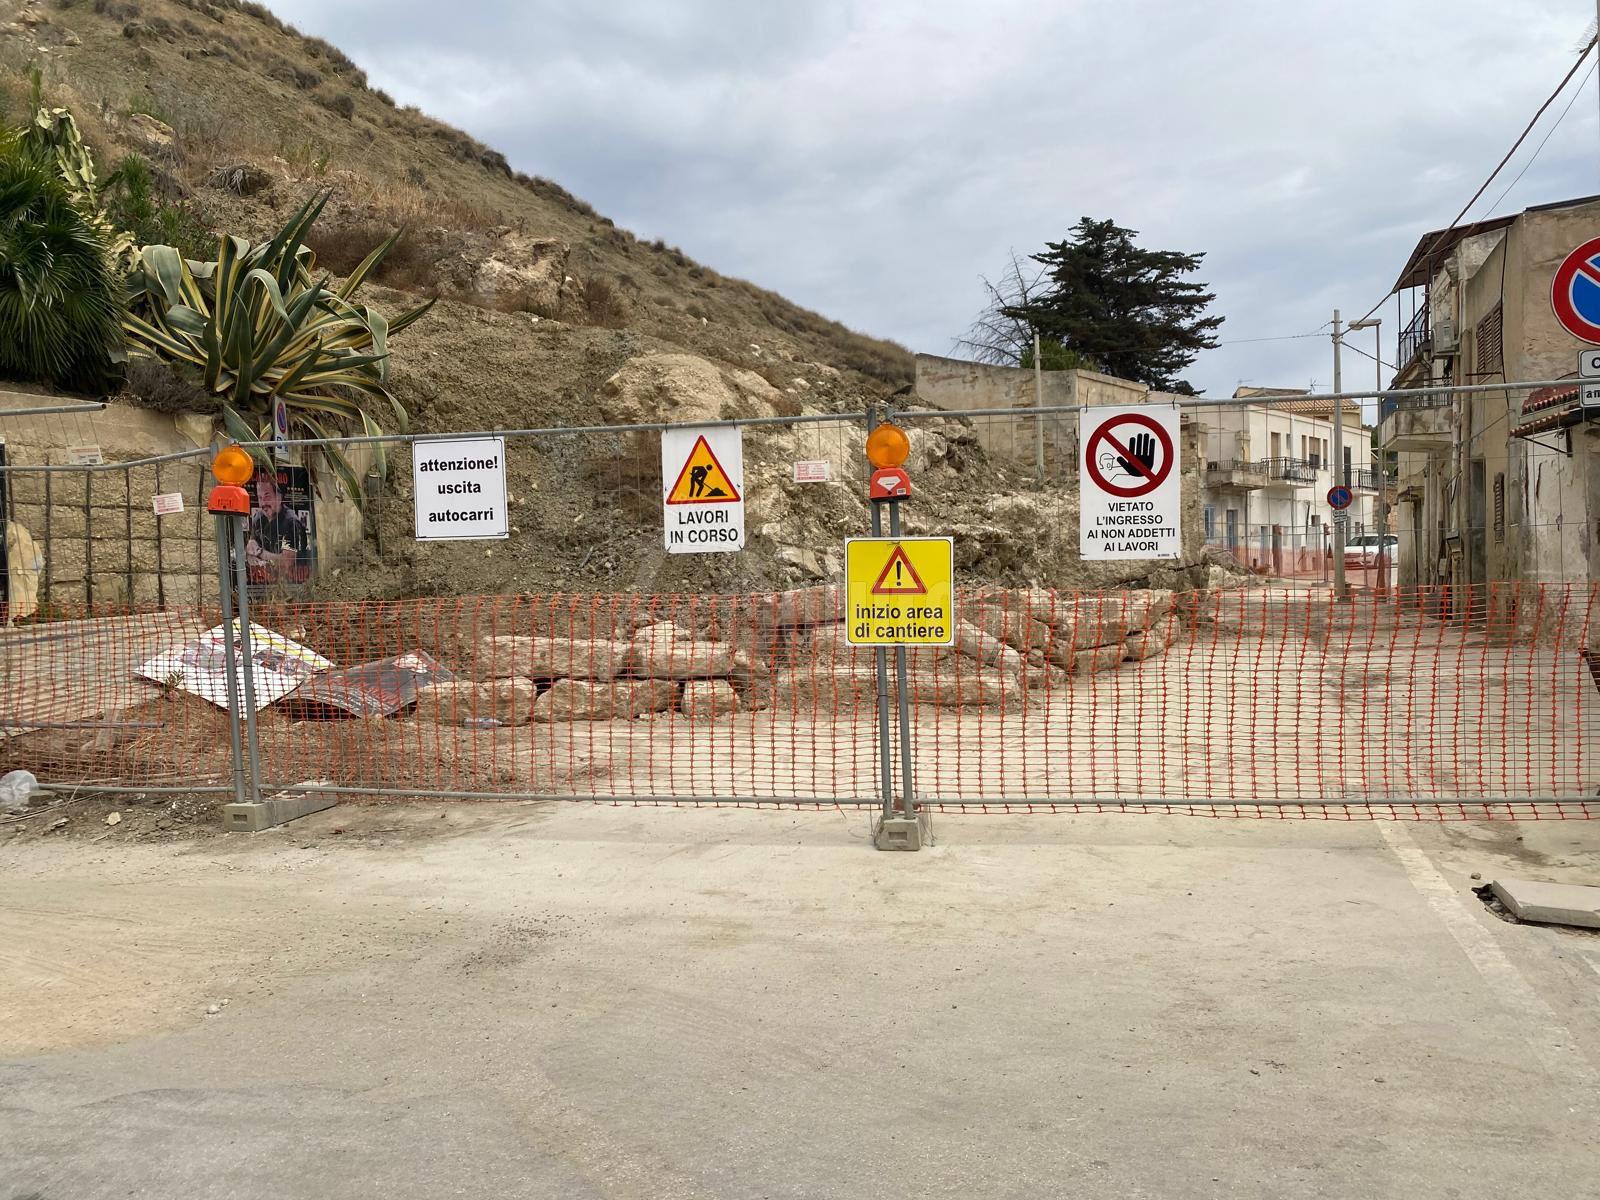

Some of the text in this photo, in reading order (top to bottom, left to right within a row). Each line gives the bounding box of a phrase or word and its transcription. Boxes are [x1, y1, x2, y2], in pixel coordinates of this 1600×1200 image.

[420, 456, 498, 472] attenzione!
[438, 481, 481, 494] uscita
[428, 507, 494, 522] autocarri
[1108, 502, 1154, 512] VIETATO
[678, 510, 729, 525] LAVORI
[1096, 515, 1163, 526] L'INGRESSO
[670, 528, 738, 543] IN CORSO
[1087, 528, 1175, 539] AI NON ADDETTI
[1104, 541, 1158, 552] AI LAVORI
[856, 604, 943, 619] inizio area
[855, 623, 944, 638] di cantiere
